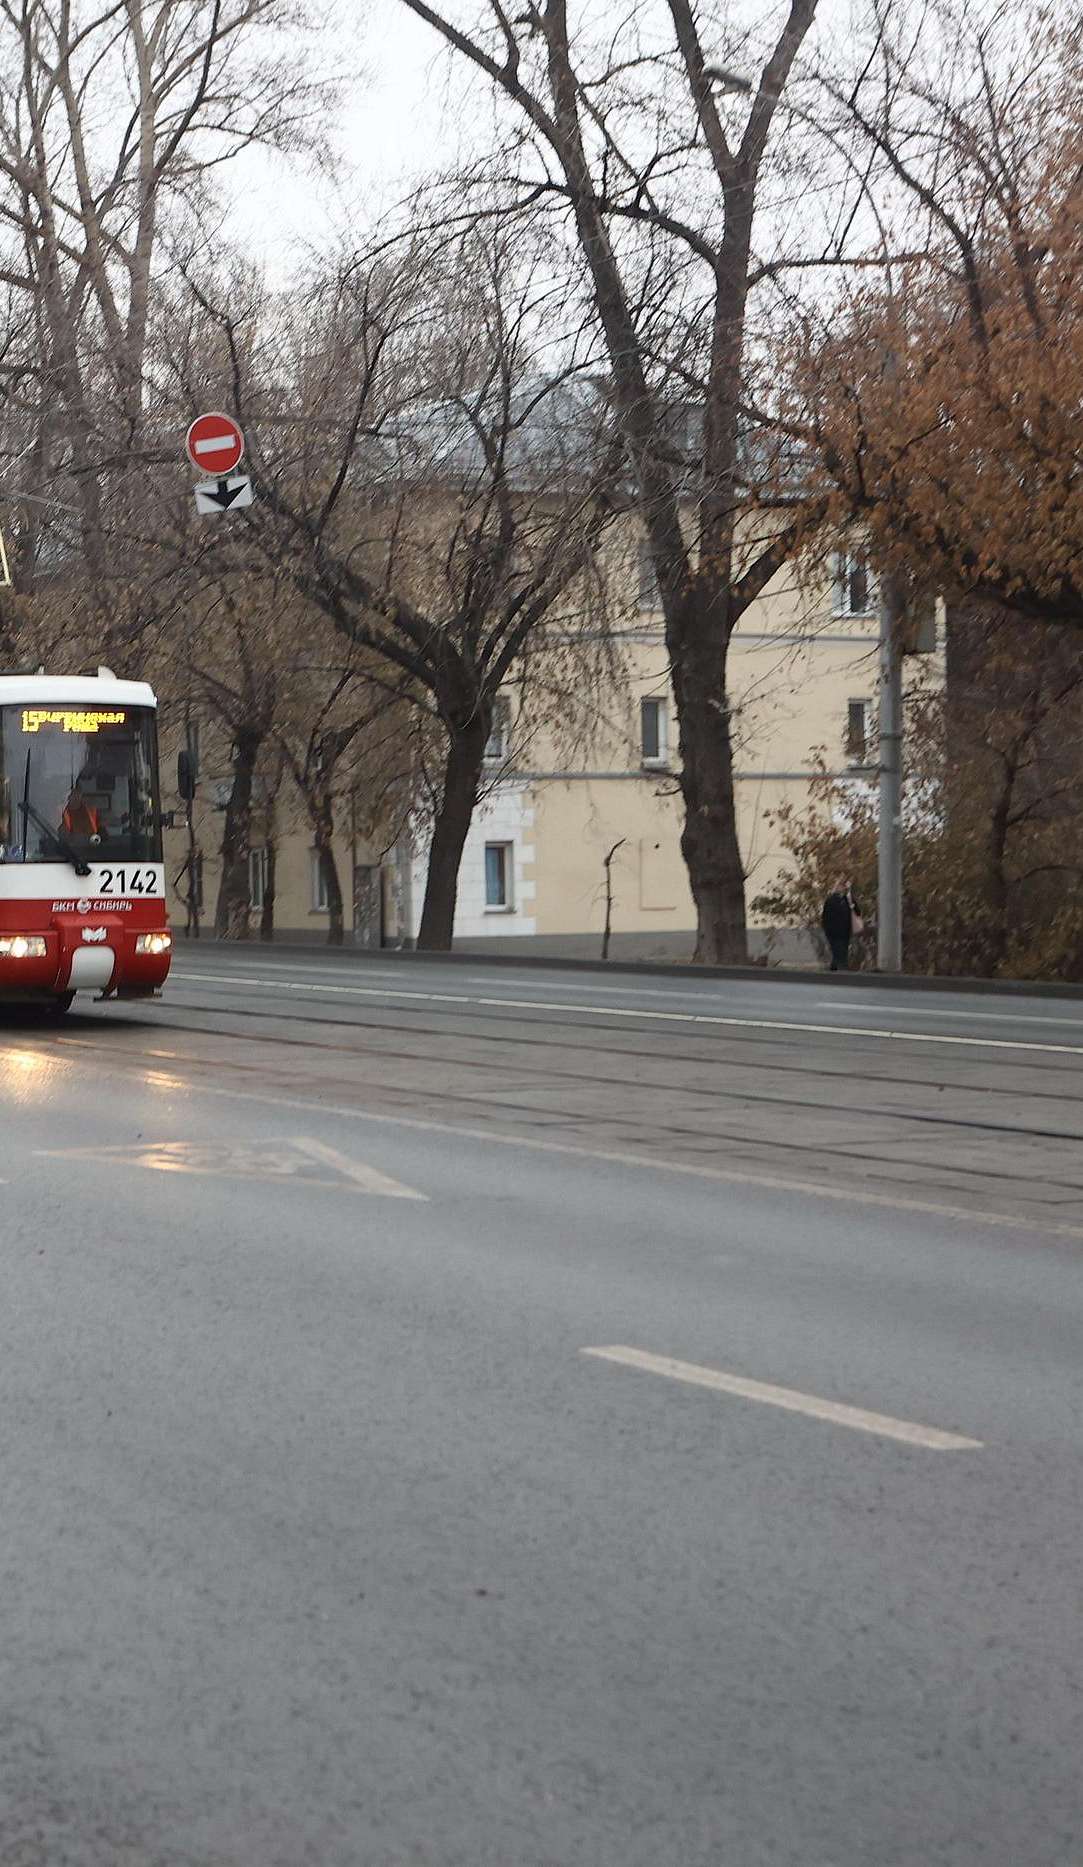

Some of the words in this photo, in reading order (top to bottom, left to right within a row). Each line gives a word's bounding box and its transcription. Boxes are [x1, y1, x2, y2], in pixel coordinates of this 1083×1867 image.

[99, 869, 158, 894] 2142
[51, 901, 75, 913] БКМ
[93, 900, 133, 912] СИБИРЬ
